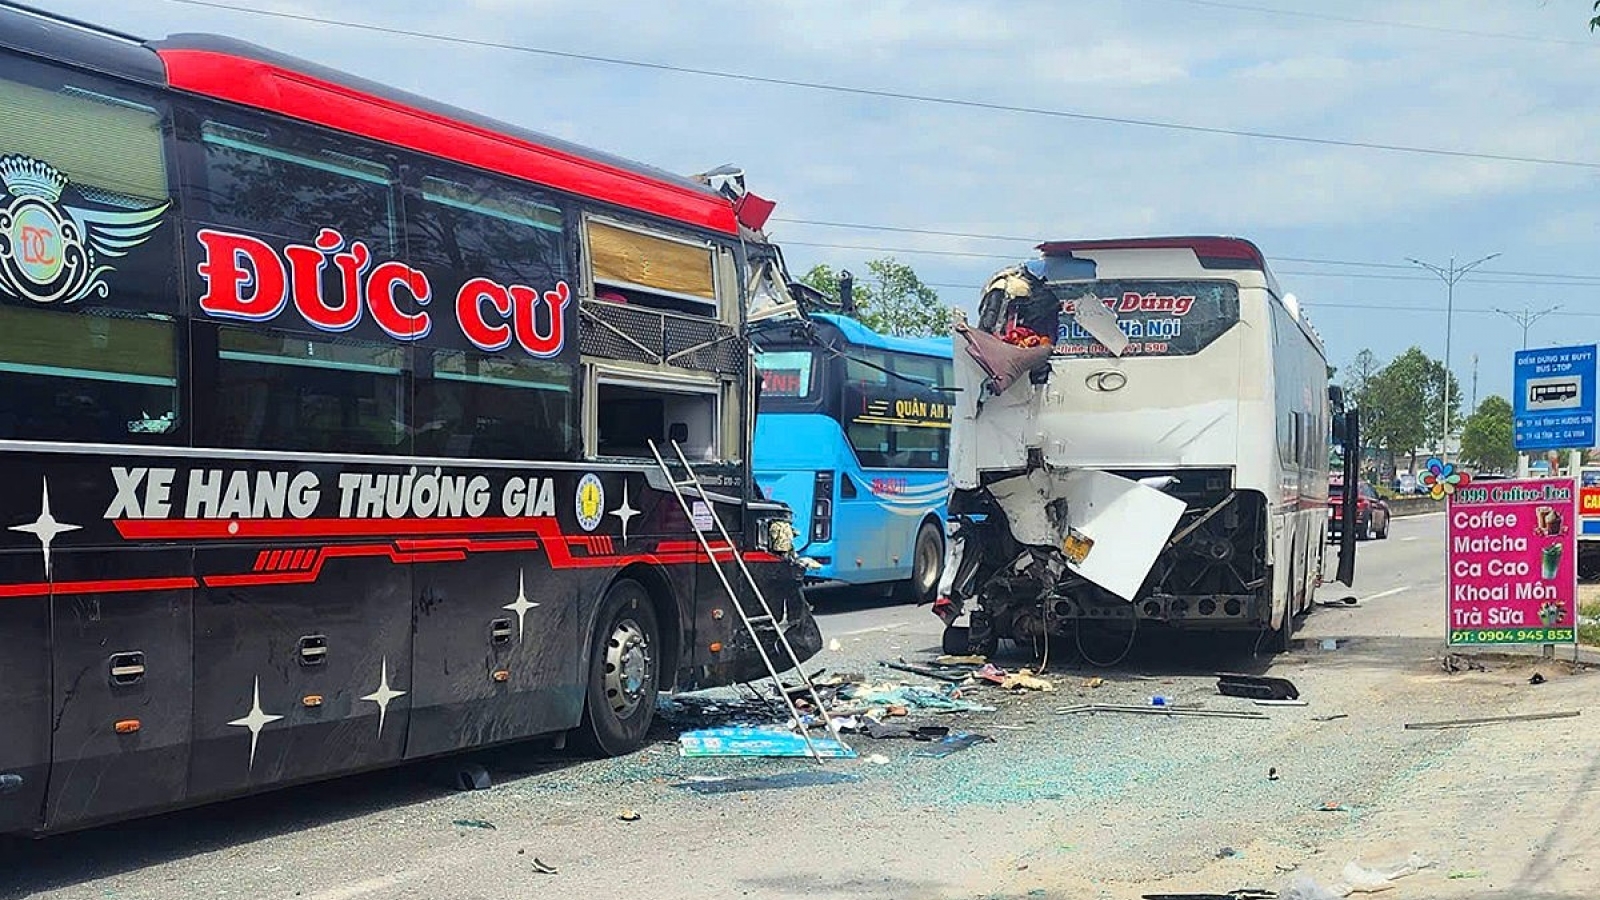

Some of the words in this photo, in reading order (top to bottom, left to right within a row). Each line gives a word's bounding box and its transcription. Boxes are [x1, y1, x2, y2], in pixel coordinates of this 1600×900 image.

[197, 228, 431, 340] ĐỨC
[455, 280, 570, 357] CƯ
[1148, 318, 1181, 339] Nội
[104, 467, 176, 518] XE
[338, 466, 490, 518] THƯƠNG
[502, 476, 556, 517] GIA
[1454, 510, 1517, 528] Coffee
[1454, 534, 1528, 553] Matcha
[1454, 560, 1481, 577] Ca
[1487, 559, 1529, 576] Cao
[1454, 583, 1509, 601] Khoai
[1515, 581, 1557, 600] Môn
[1454, 607, 1482, 625] Trà
[1487, 607, 1524, 624] Sữa
[1477, 631, 1513, 641] 0904
[1517, 630, 1544, 640] 945
[1547, 630, 1573, 640] 853
